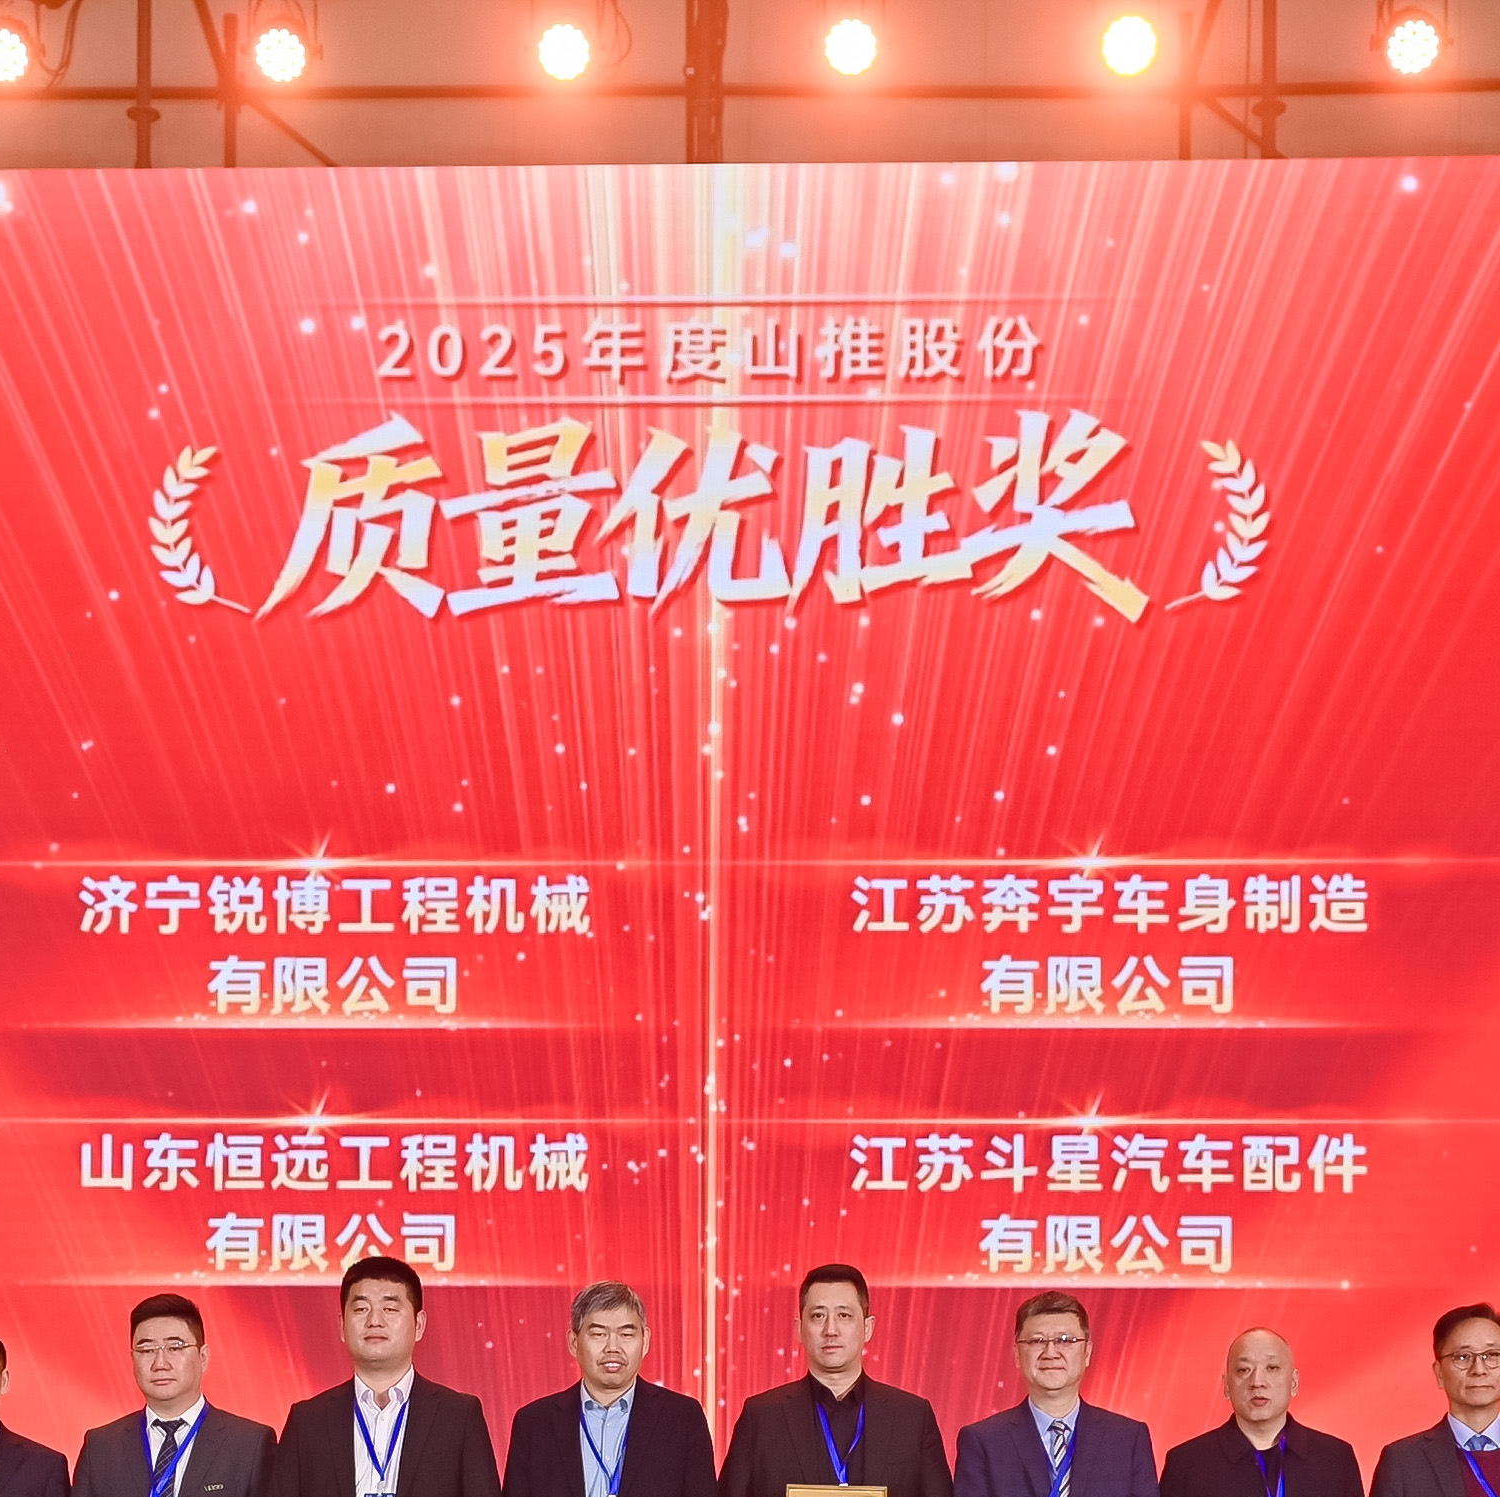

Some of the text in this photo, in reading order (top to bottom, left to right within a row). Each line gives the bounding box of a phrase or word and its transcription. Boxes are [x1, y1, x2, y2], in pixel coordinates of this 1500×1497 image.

[376, 315, 1044, 384] 2025年度山推股份
[257, 408, 1150, 622] 质量优胜奖
[78, 875, 591, 935] 济宁锐博工程机械
[850, 874, 1369, 935] 江苏奔宇车身制造
[208, 955, 458, 1015] 有限公司
[980, 955, 1235, 1015] 有限公司
[79, 1132, 590, 1192] 山东恒远工程机械
[849, 1134, 1369, 1194] 江苏斗星汽车配件
[206, 1212, 456, 1272] 有限公司
[979, 1214, 1234, 1274] 有限公司
